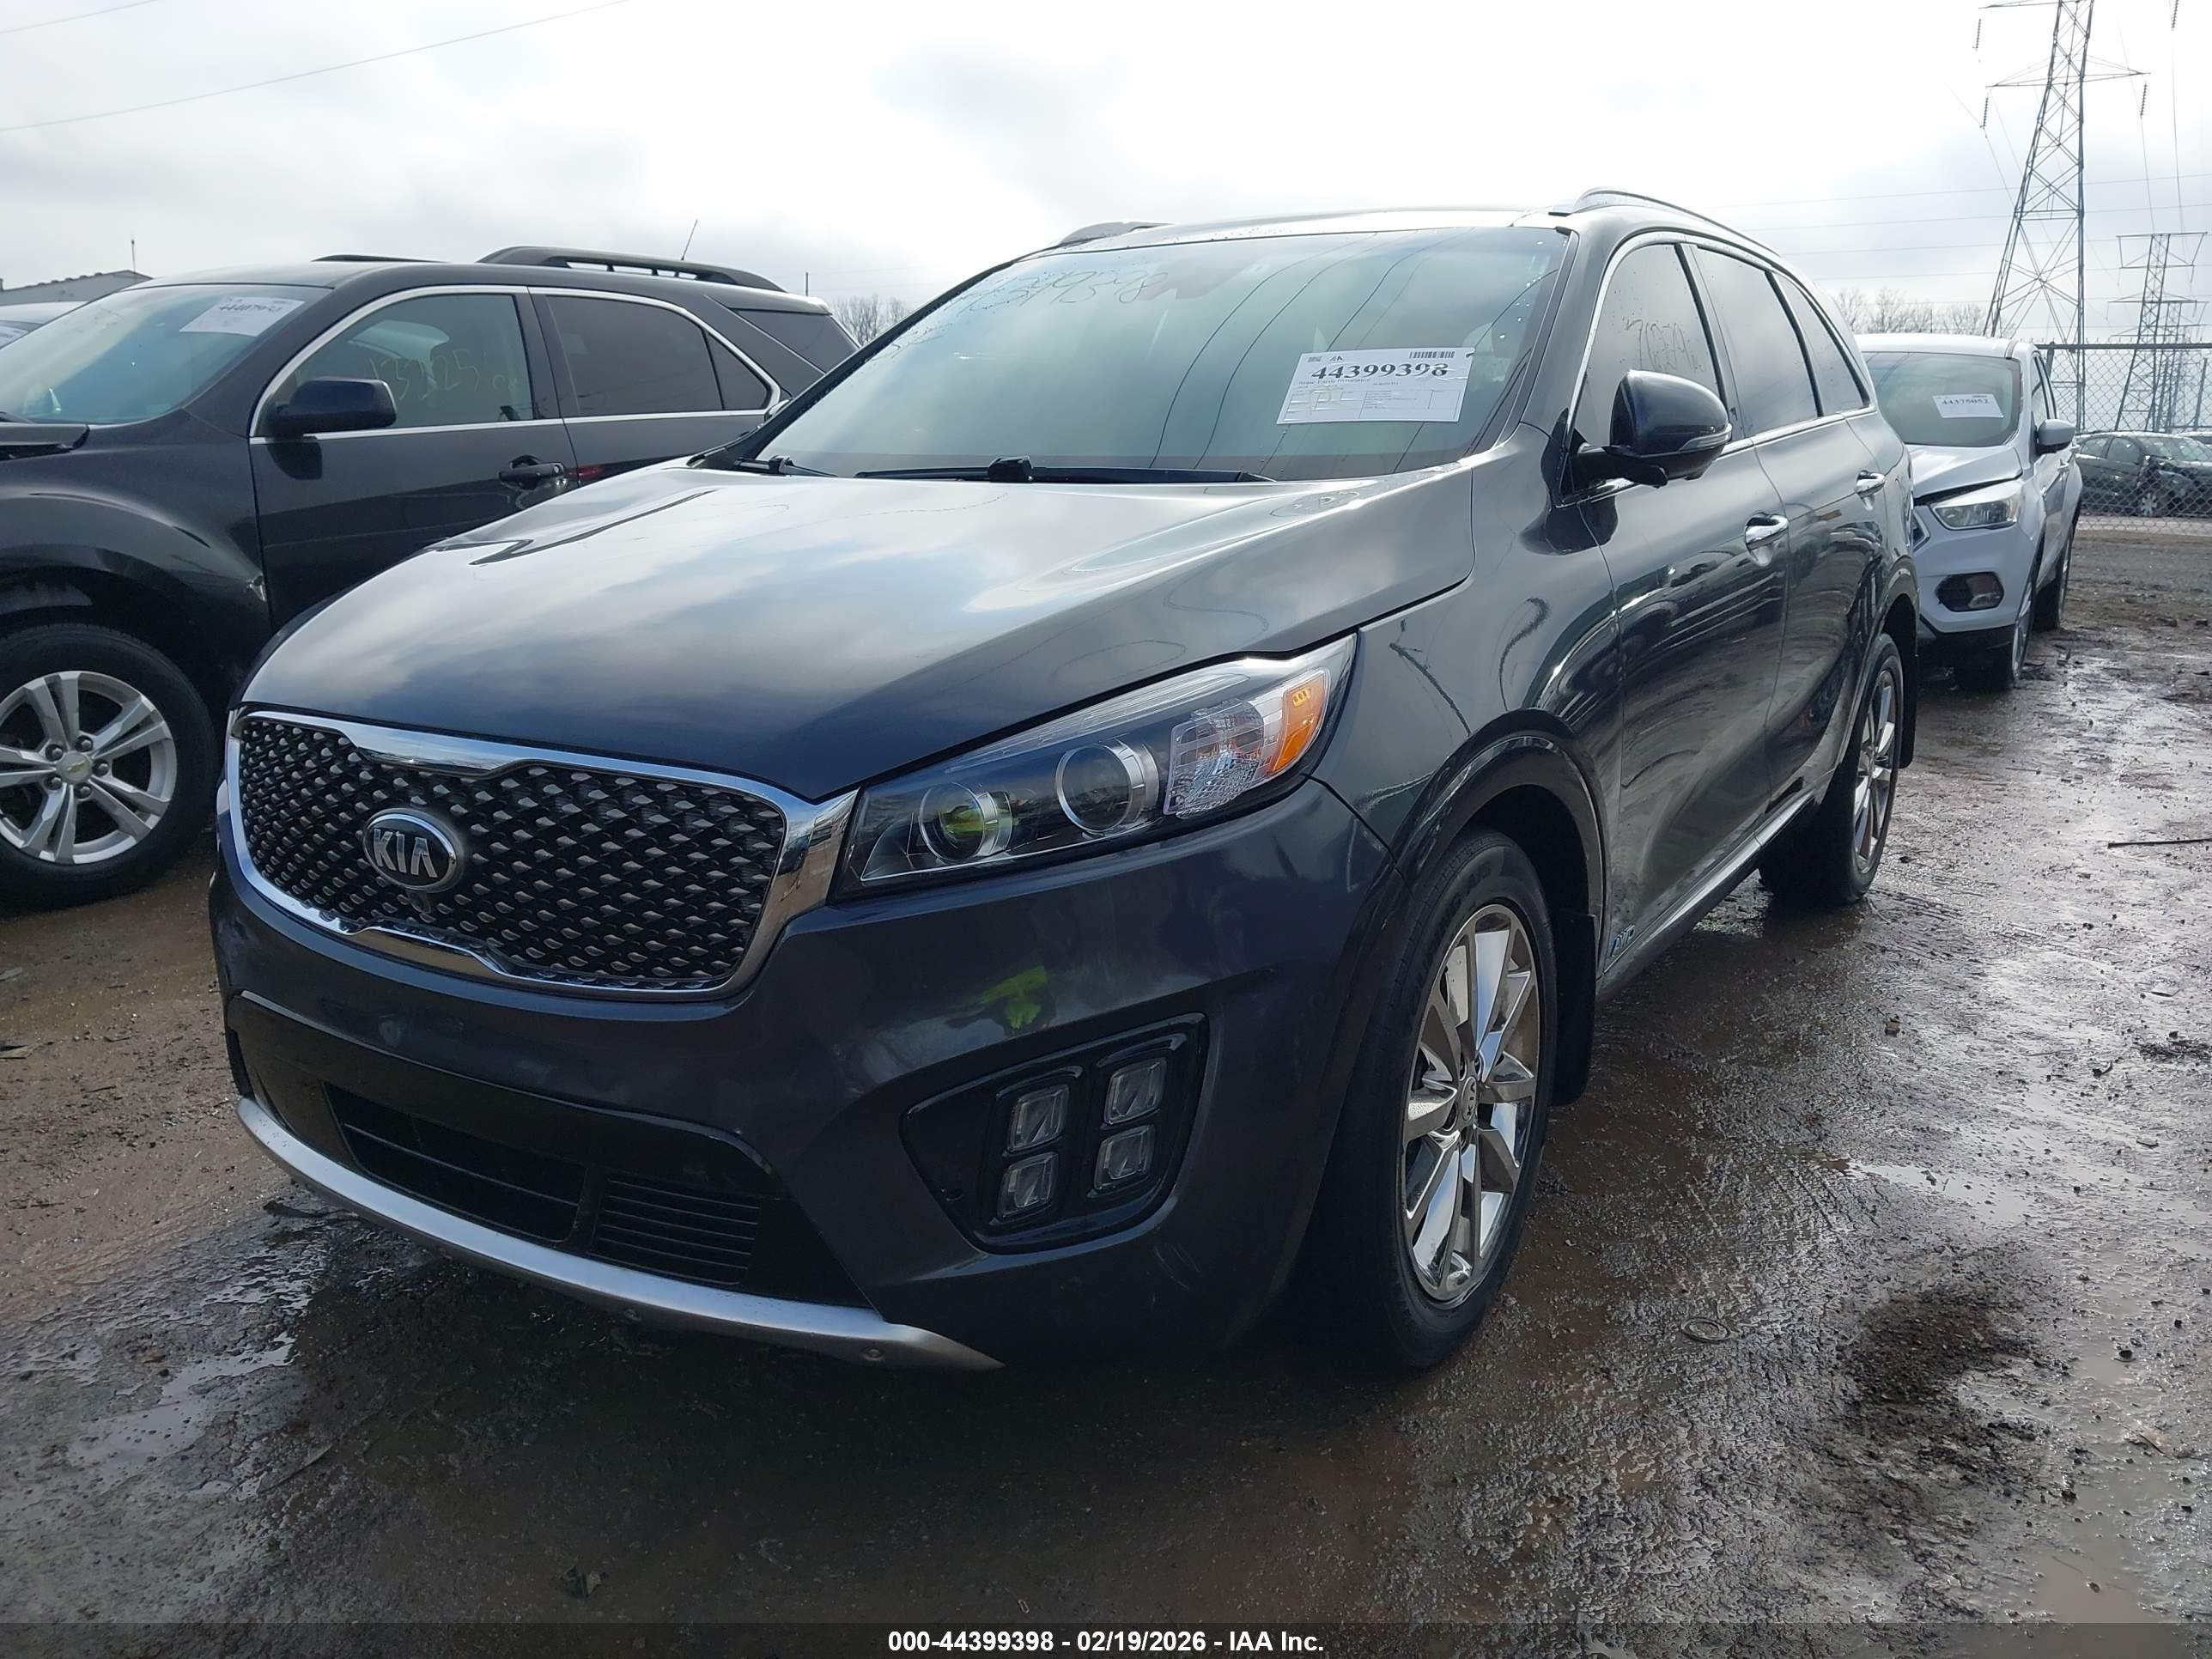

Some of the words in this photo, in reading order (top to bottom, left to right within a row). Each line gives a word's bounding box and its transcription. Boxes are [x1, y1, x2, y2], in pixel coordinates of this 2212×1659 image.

[1311, 363, 1449, 380] 44399398
[373, 828, 440, 879] KIA
[1466, 1080, 1476, 1116] KIA
